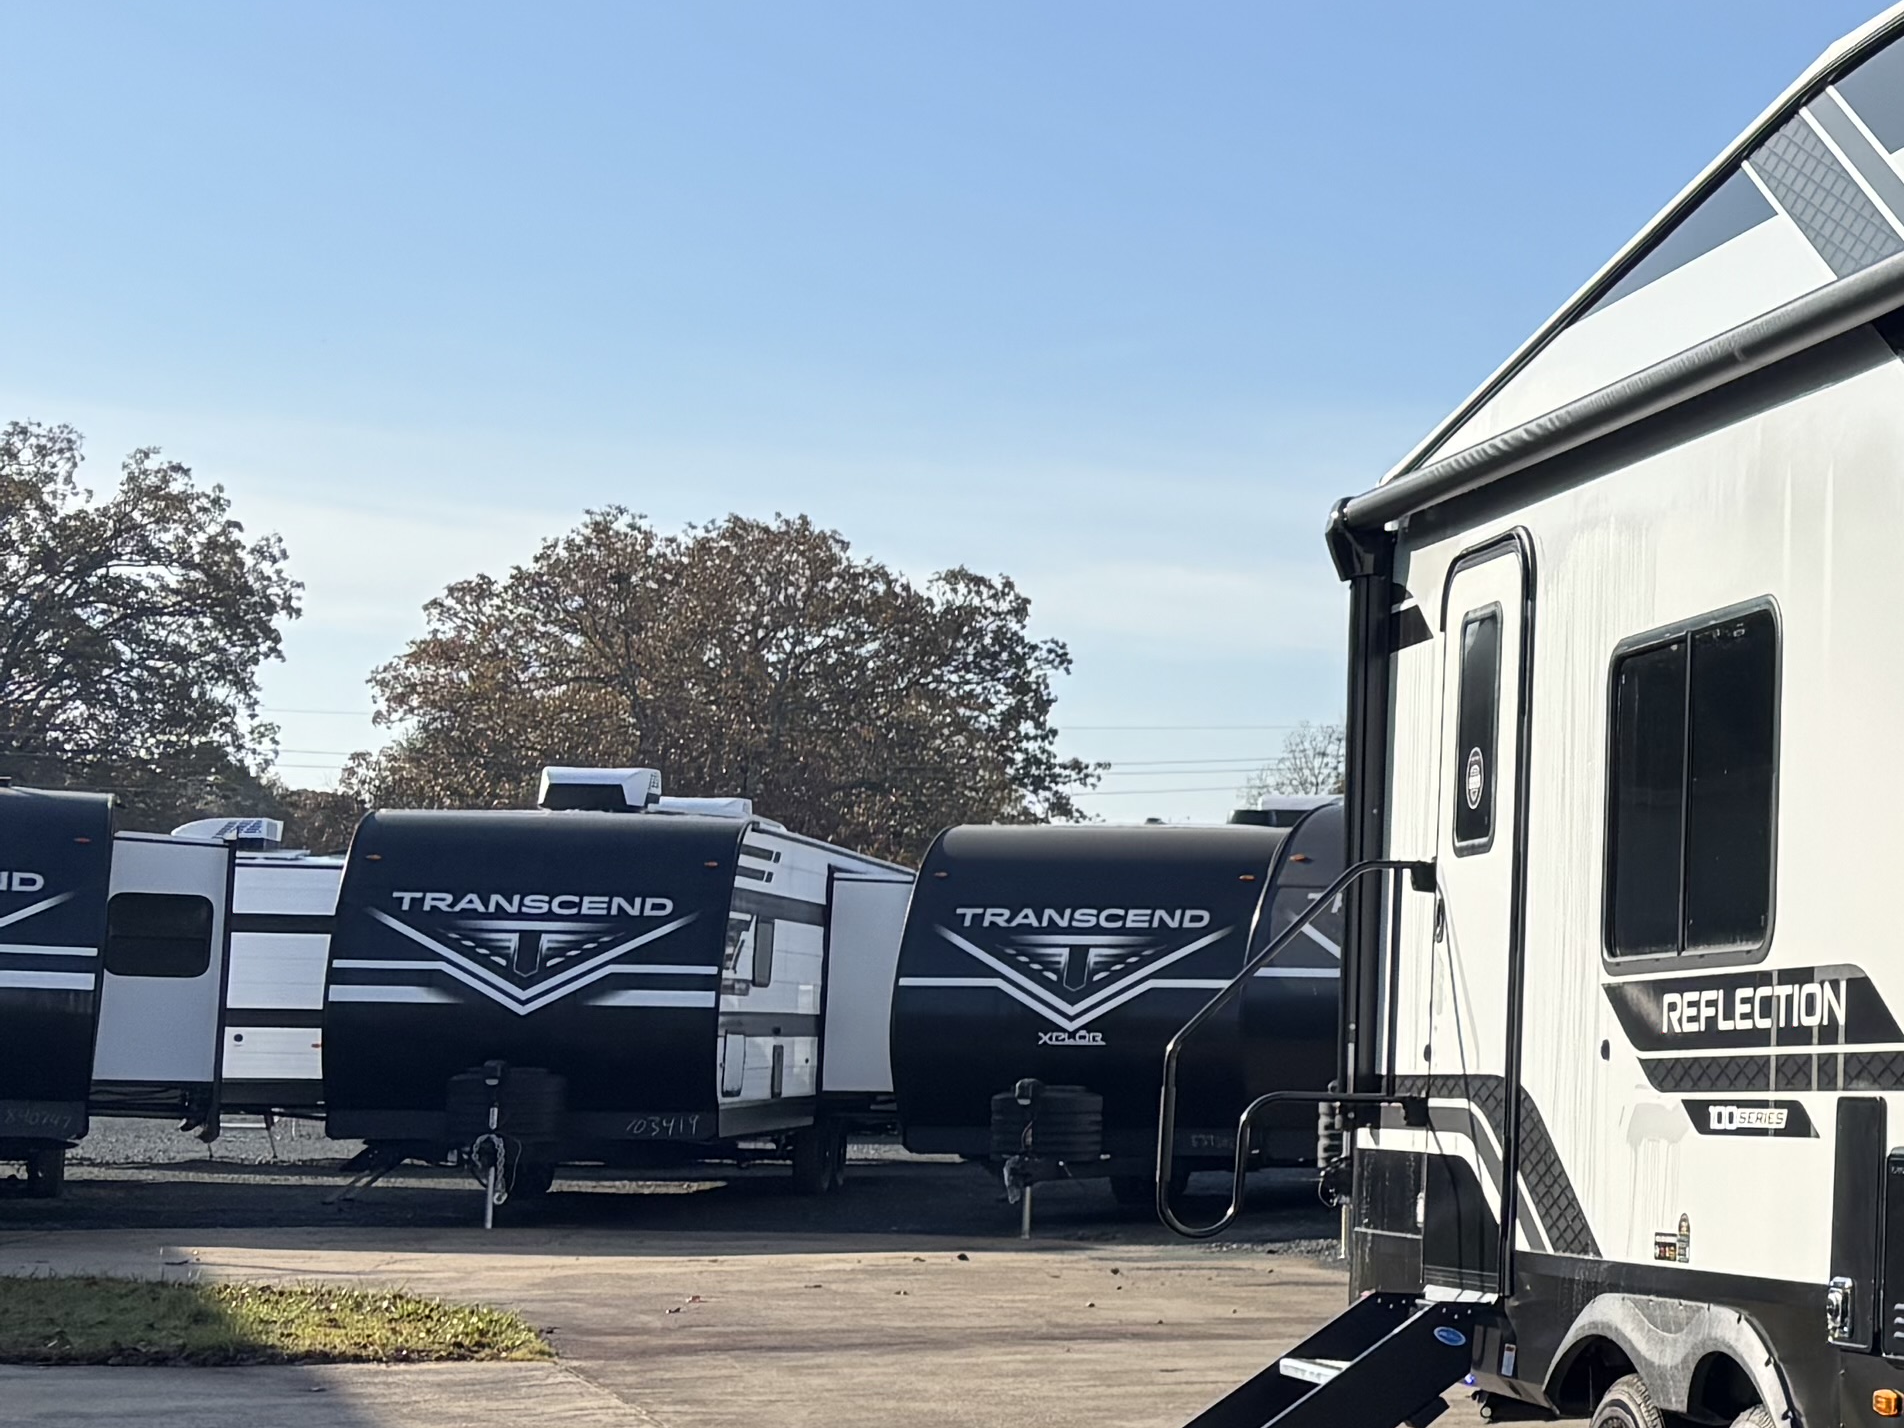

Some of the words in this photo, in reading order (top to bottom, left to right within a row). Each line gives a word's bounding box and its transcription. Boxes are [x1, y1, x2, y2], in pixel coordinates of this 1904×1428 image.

[392, 891, 674, 917] TRANSCEND
[955, 908, 1211, 929] TRANSCEND
[1662, 980, 1847, 1034] REFLECTION
[1708, 1105, 1738, 1131] 100
[1738, 1111, 1785, 1126] SERIES
